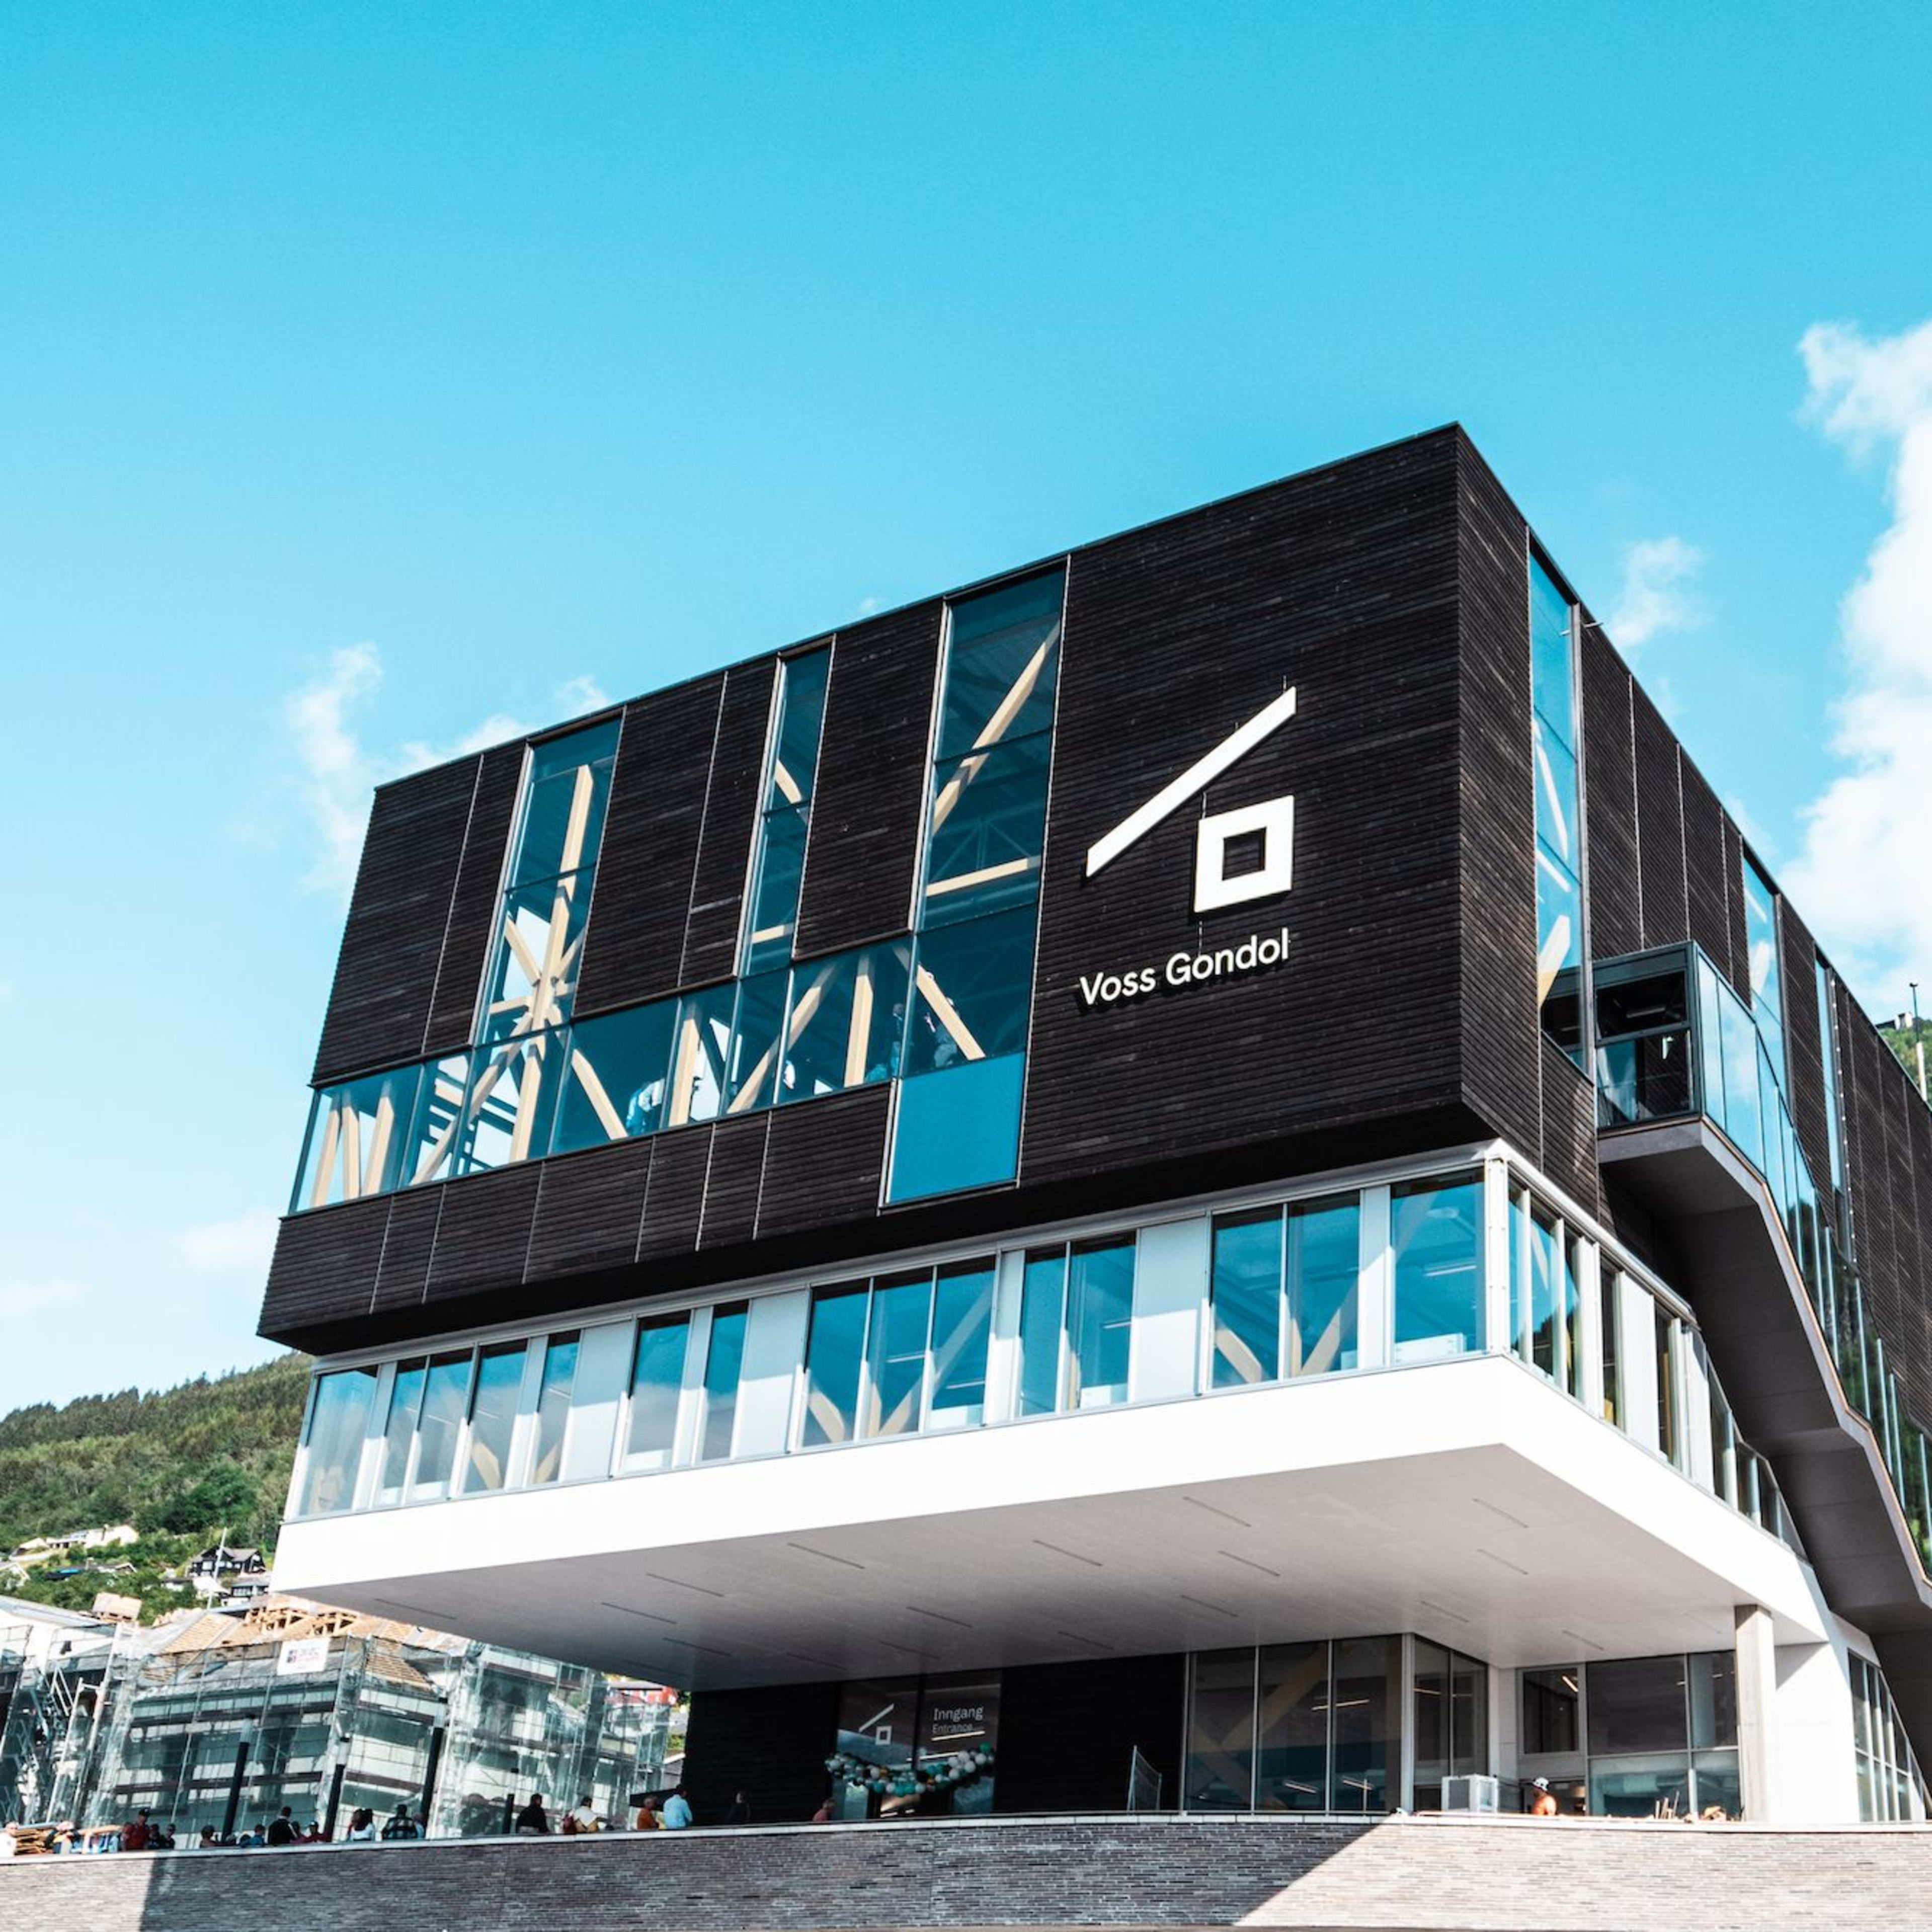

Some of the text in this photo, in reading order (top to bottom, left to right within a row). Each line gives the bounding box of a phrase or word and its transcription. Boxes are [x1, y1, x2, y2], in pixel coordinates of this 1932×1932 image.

[1080, 927, 1289, 1005] Voss Gondol
[933, 1706, 984, 1722] Inngang
